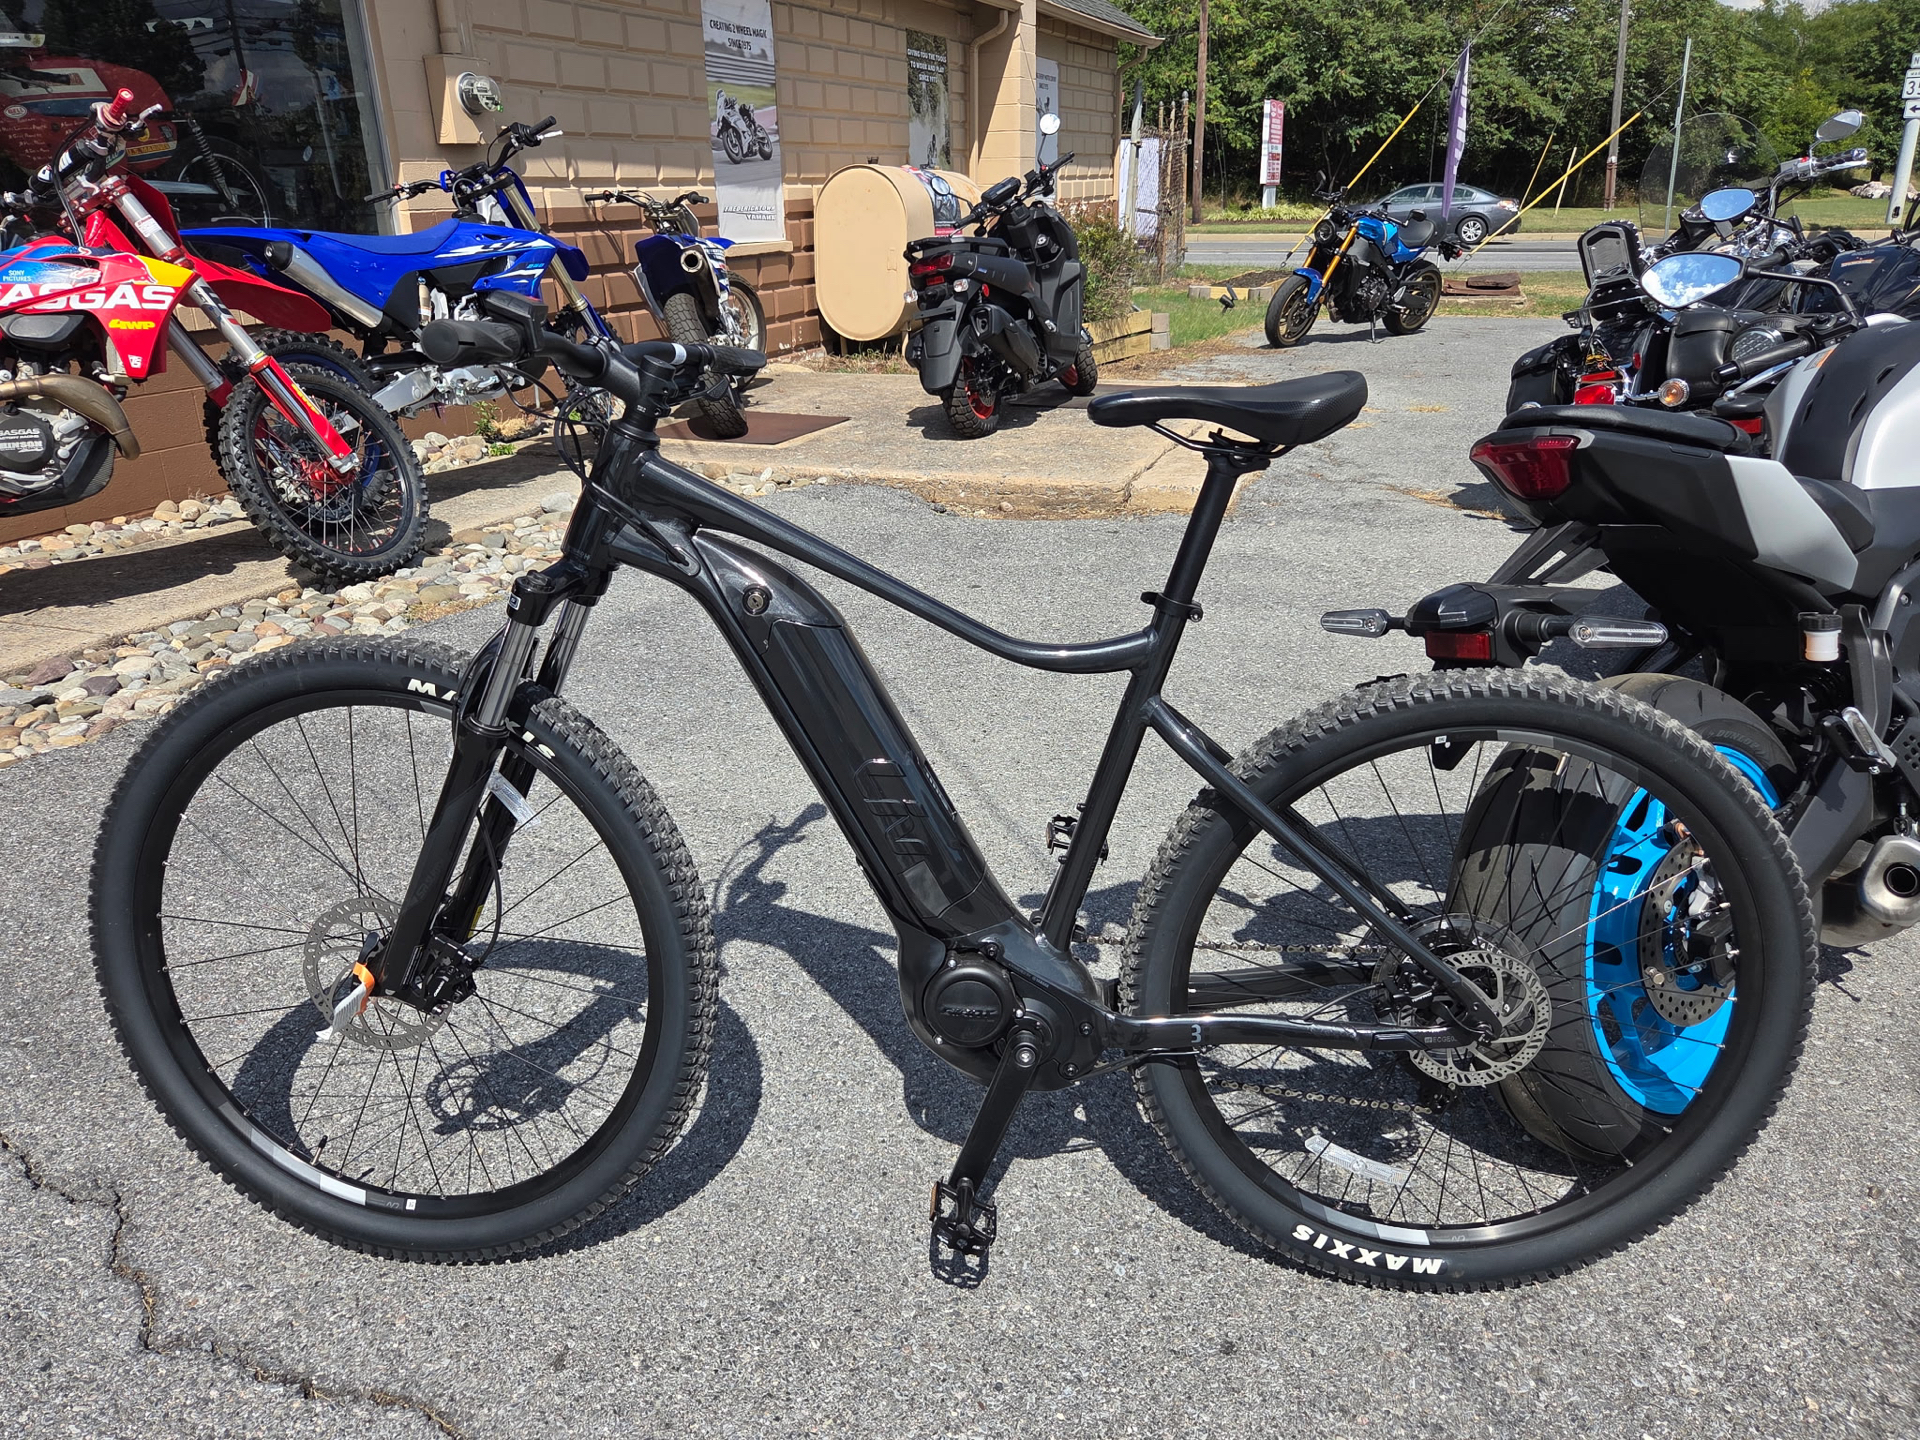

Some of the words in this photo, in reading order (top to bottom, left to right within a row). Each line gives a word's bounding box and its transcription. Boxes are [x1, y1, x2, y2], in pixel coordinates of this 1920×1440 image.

[710, 20, 732, 33] CREATING
[736, 25, 752, 36] WHEEL
[753, 28, 767, 39] MAGIC
[728, 38, 741, 49] SINCE
[741, 40, 752, 51] 1975
[910, 60, 916, 69] TO
[8, 107, 25, 115] BELL
[0, 283, 176, 310] ASGAS
[1190, 1023, 1202, 1043] 3
[1291, 1224, 1444, 1275] MAXXIS
